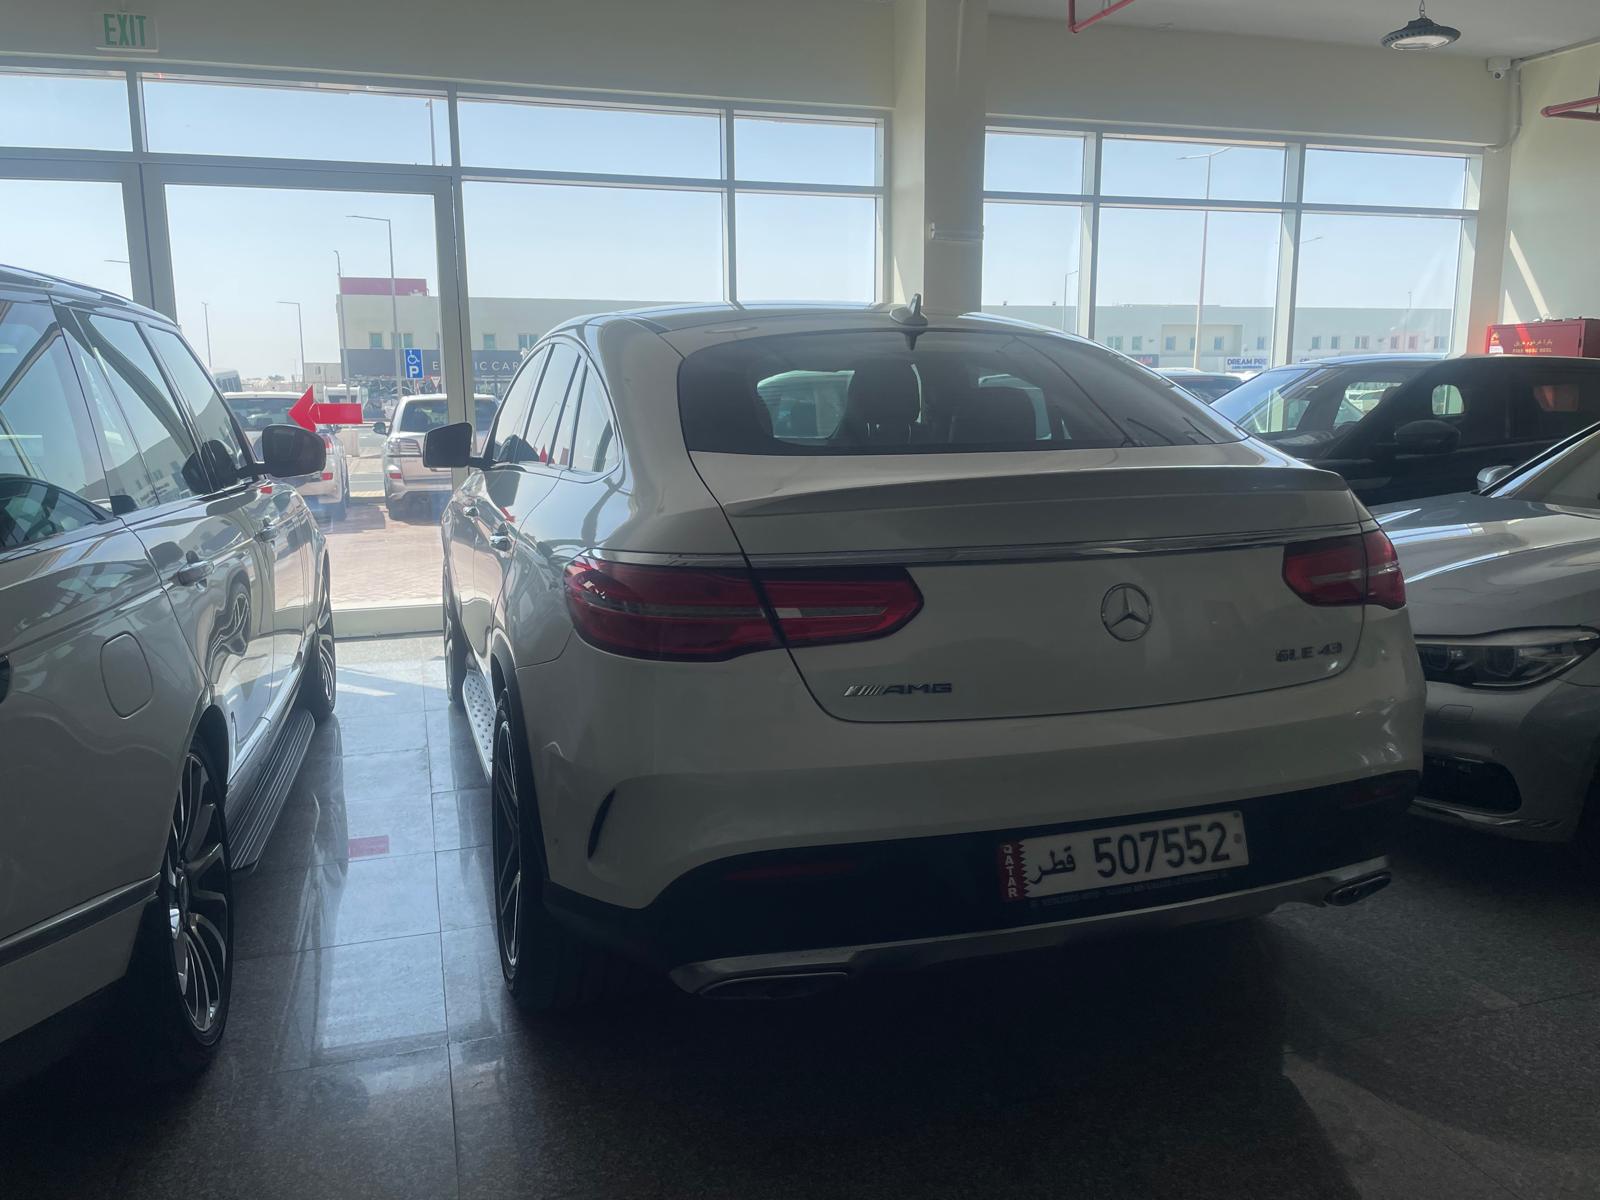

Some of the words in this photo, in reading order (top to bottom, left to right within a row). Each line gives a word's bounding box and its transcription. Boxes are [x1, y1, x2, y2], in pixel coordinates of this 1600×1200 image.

[103, 13, 146, 46] EXIT
[409, 365, 419, 377] P
[1275, 646, 1314, 662] GLE
[1317, 641, 1343, 656] 43
[1027, 845, 1077, 885] قطر
[1092, 821, 1231, 879] 507552
[1003, 844, 1019, 898] QATAR
